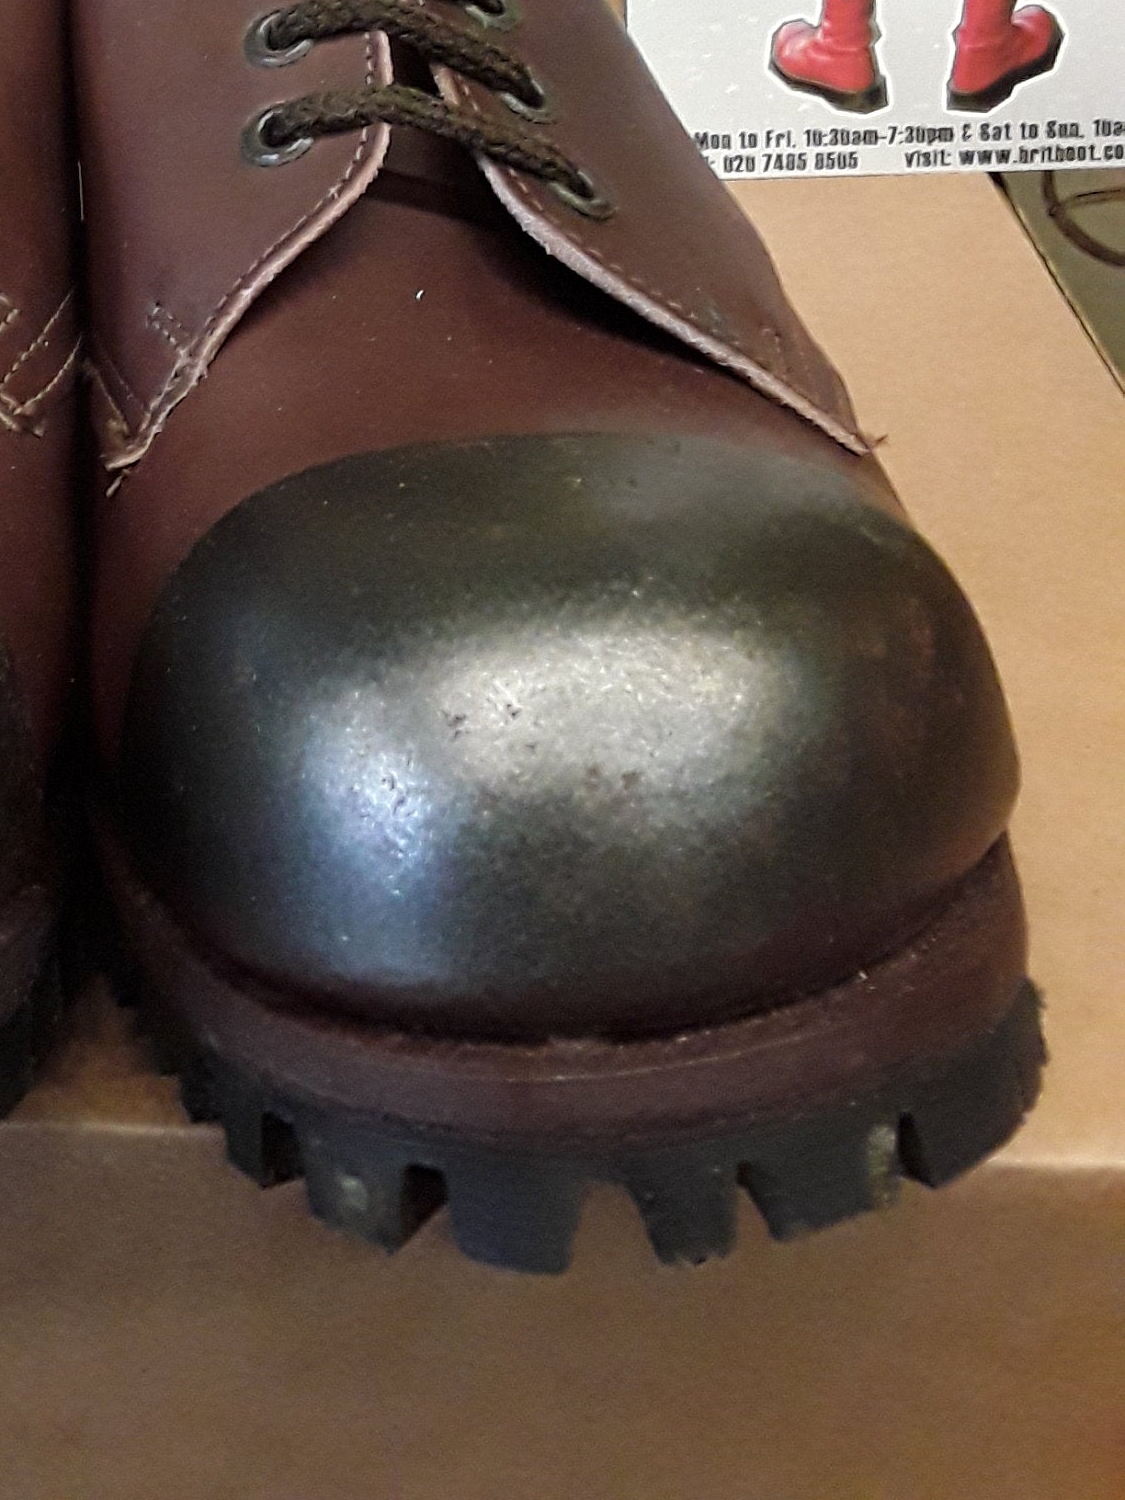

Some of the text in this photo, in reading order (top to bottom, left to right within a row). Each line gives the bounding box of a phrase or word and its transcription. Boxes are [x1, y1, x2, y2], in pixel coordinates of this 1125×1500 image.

[739, 130, 757, 149] to
[979, 122, 1012, 142] Sat
[1020, 122, 1039, 140] to
